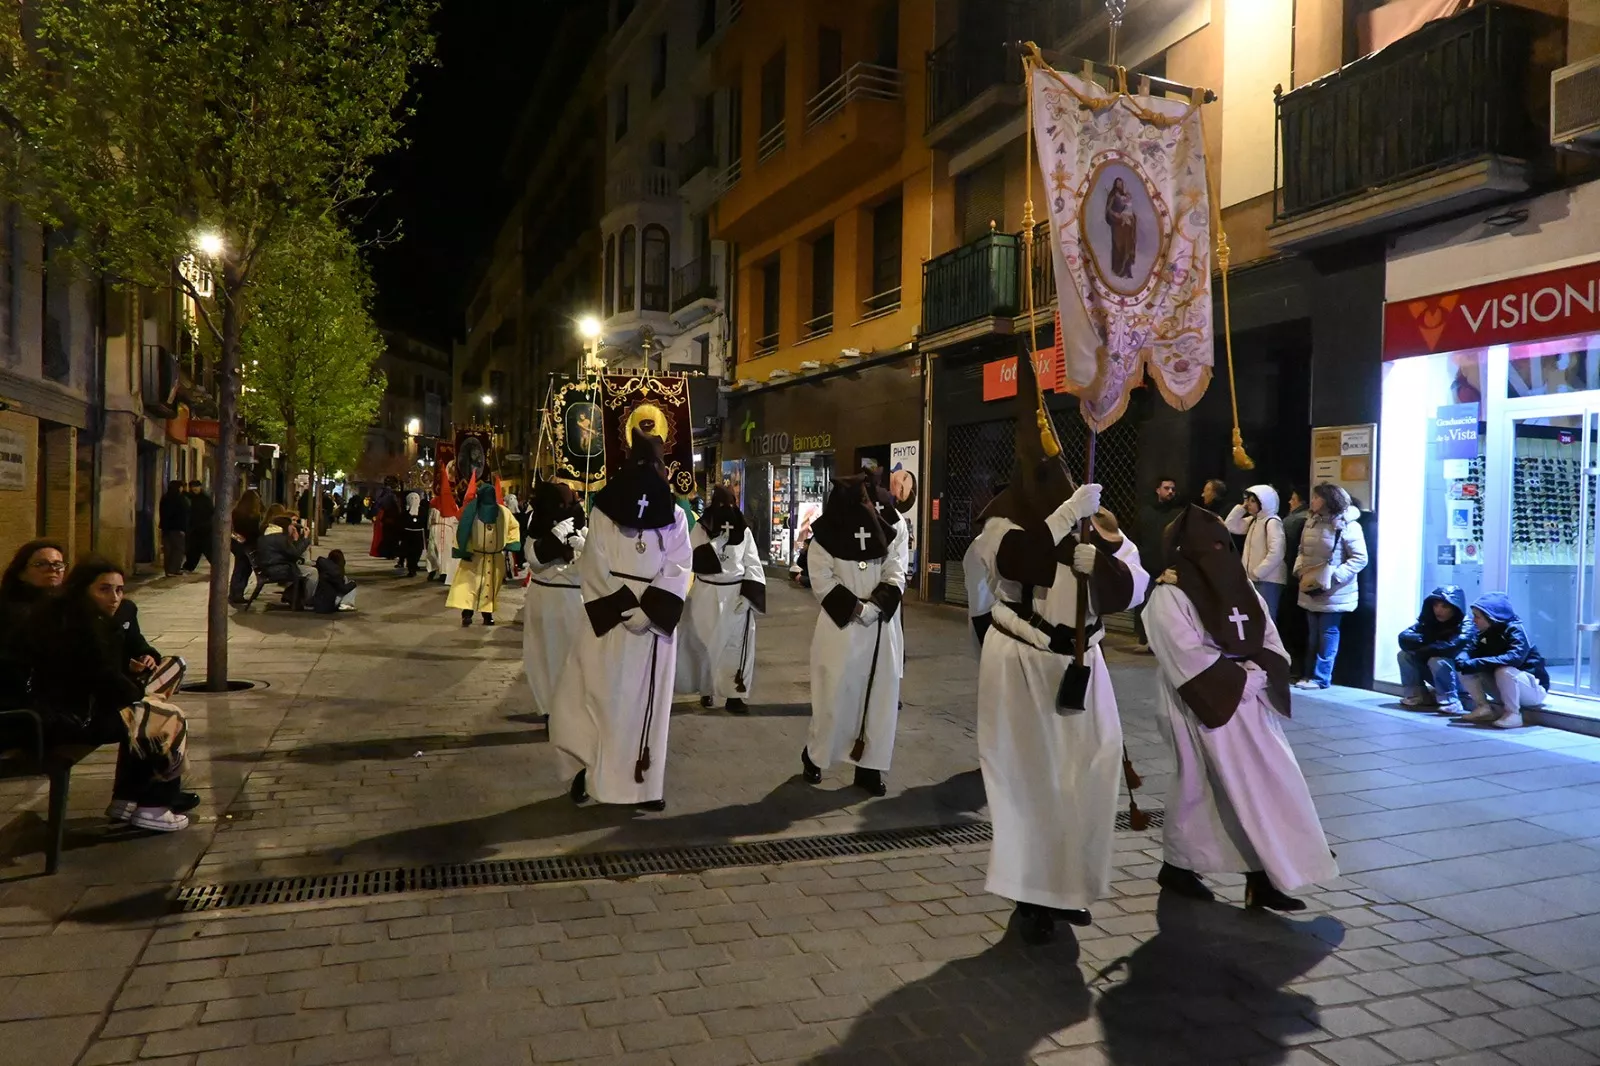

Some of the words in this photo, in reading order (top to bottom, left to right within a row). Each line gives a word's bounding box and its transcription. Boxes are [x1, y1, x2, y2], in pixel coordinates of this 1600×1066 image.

[1436, 416, 1477, 426] Graduación
[1449, 428, 1477, 440] Vista
[793, 431, 831, 451] farmacia
[893, 445, 917, 457] PHYTO
